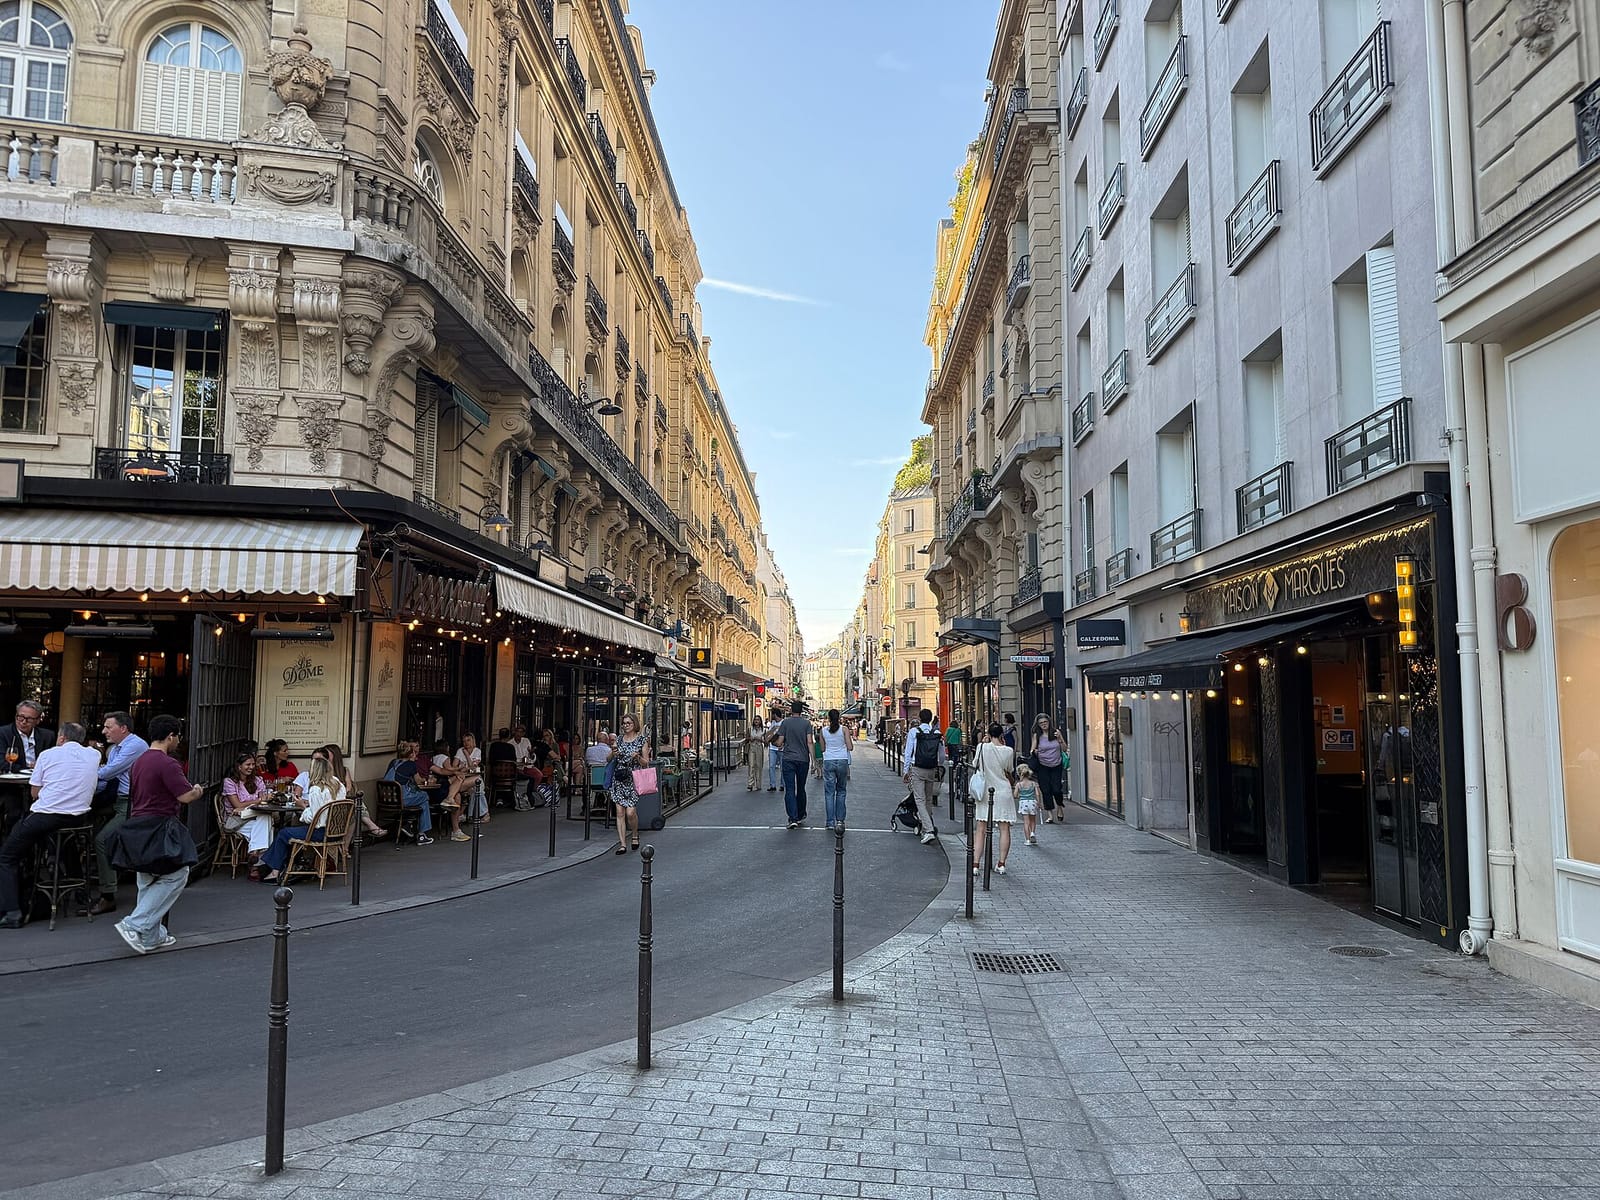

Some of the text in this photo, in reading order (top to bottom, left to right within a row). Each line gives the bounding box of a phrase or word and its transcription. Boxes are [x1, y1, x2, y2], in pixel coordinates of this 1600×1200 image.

[1222, 556, 1345, 616] MAISON MARQUES
[1153, 721, 1183, 736] REX
